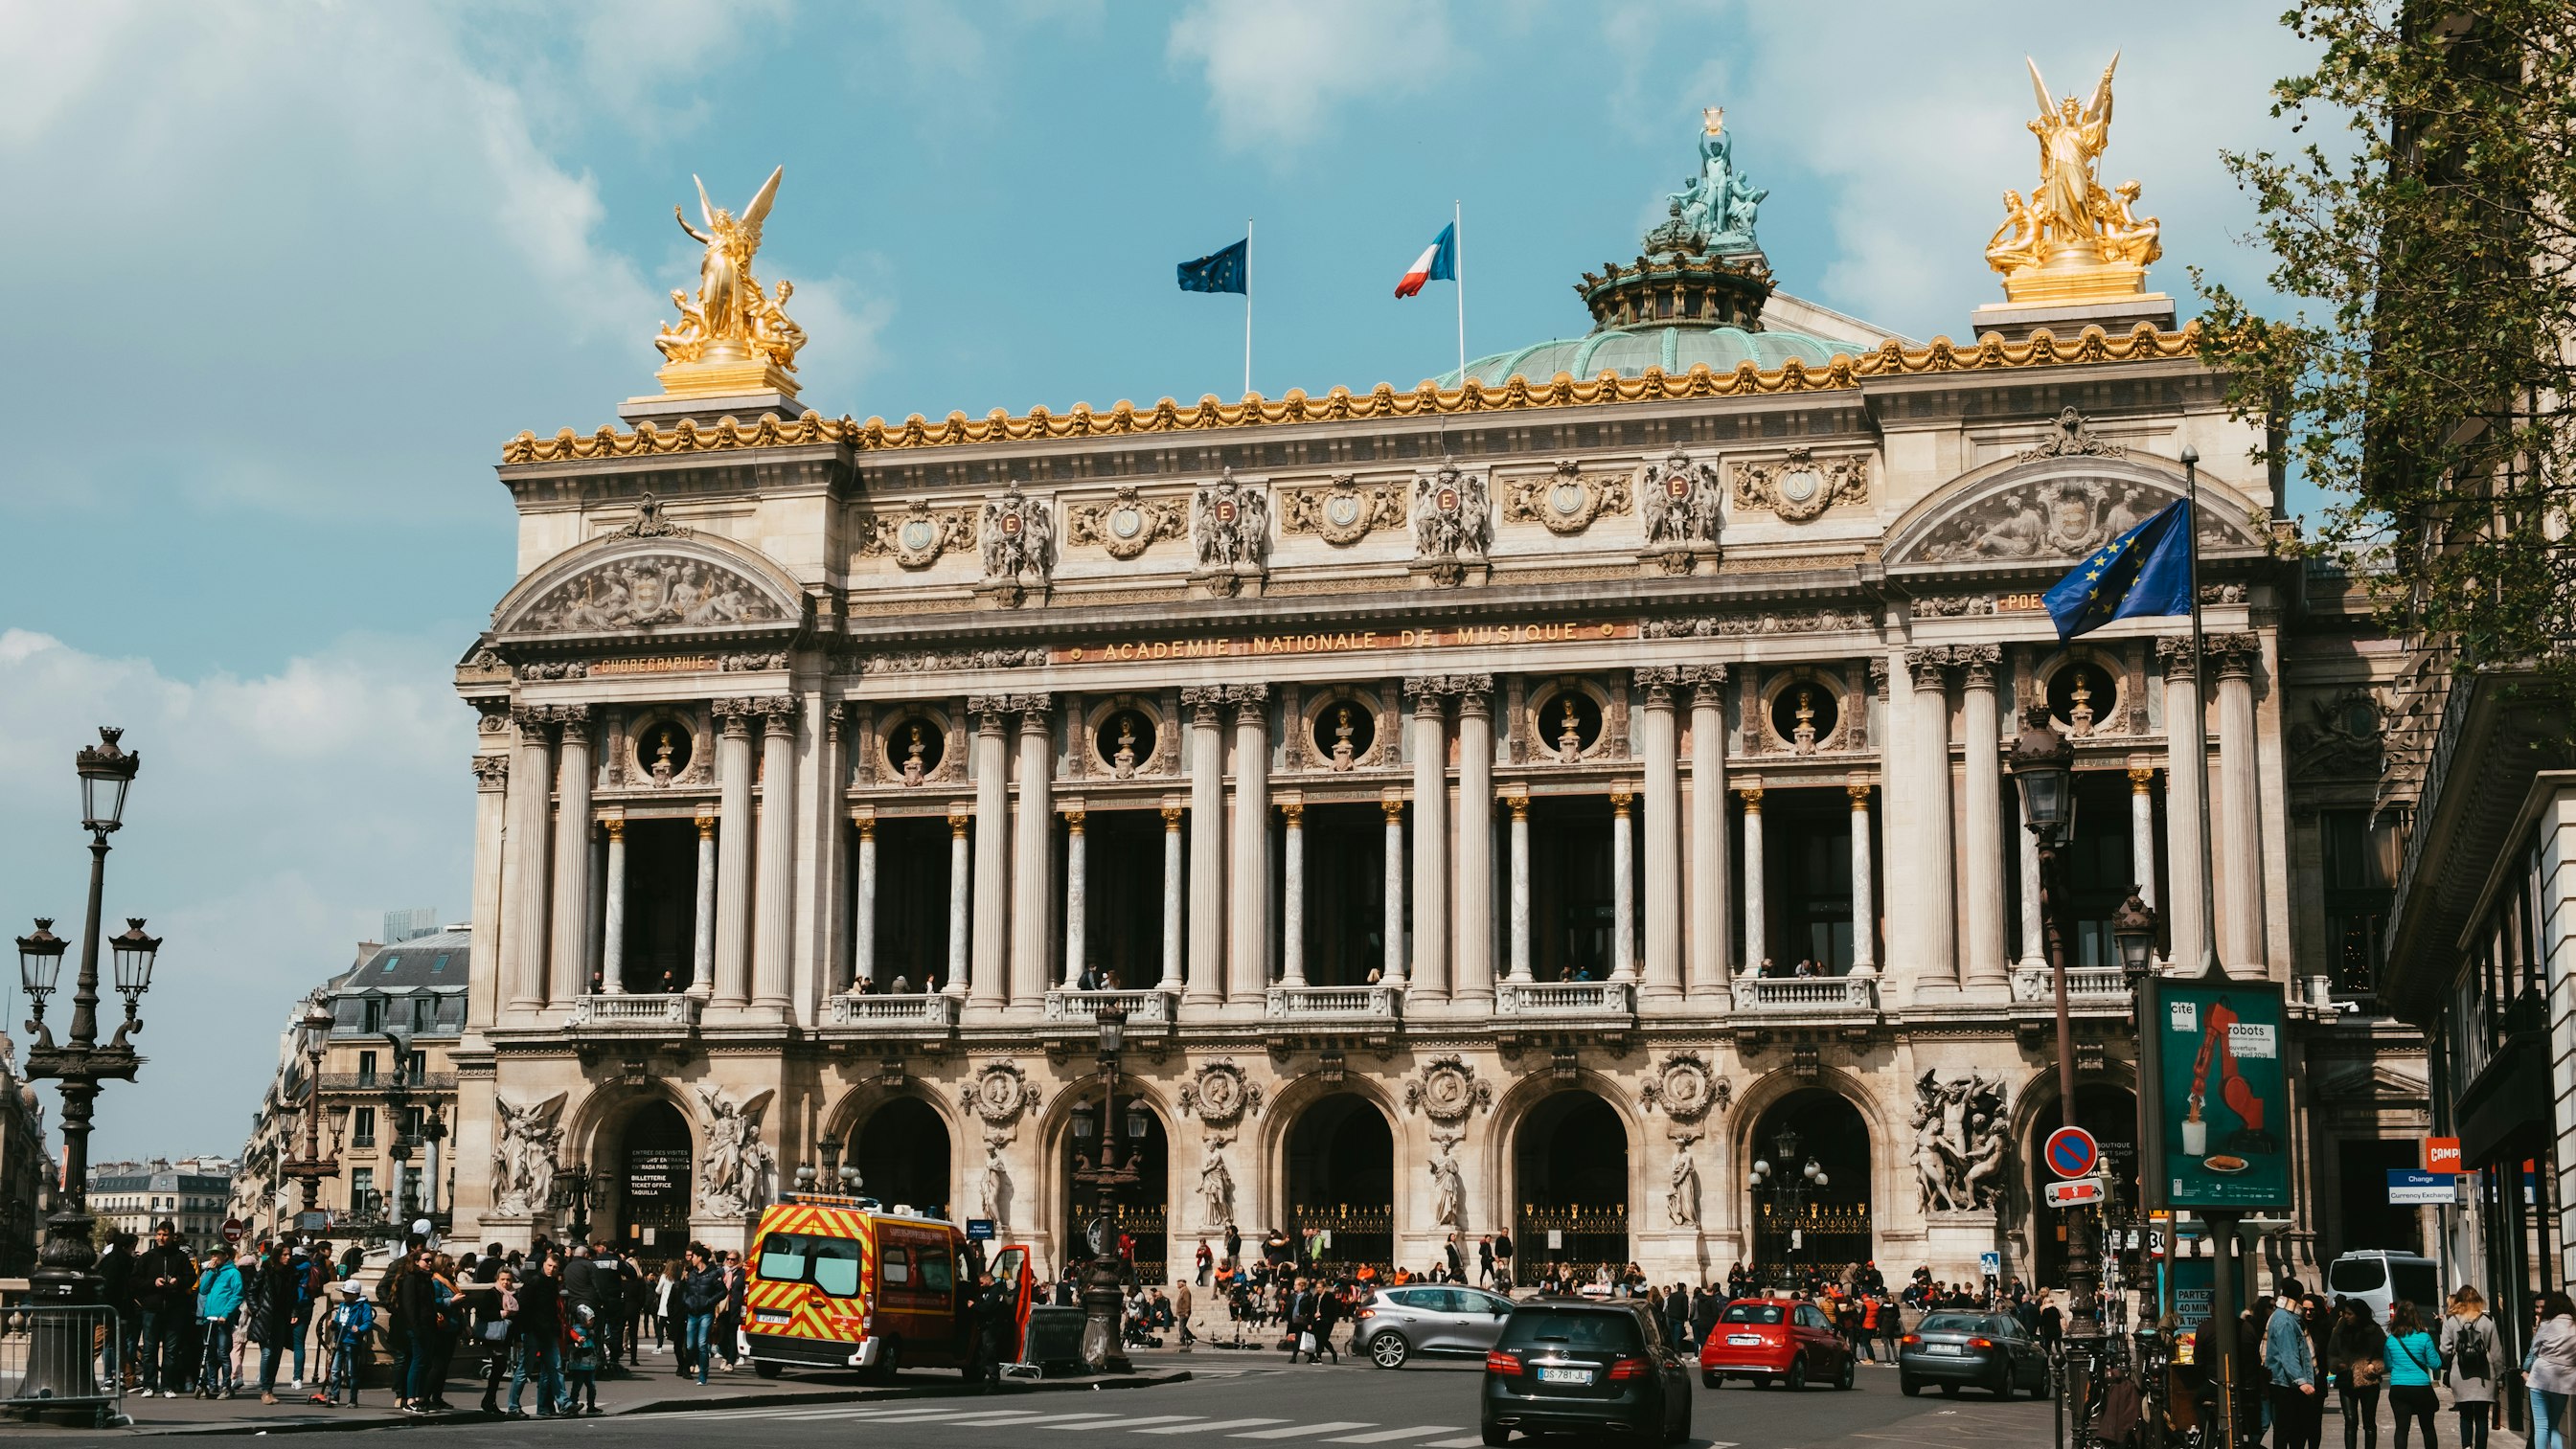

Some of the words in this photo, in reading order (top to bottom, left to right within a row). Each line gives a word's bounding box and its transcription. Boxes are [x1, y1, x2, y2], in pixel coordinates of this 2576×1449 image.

[1672, 481, 1682, 495] E
[1442, 493, 1452, 508] E
[1220, 505, 1230, 519] E
[1006, 518, 1015, 532] E
[1103, 638, 1229, 661] ACADEMIE
[1253, 631, 1377, 654] NATIONALE
[1401, 628, 1433, 647] DE
[1457, 623, 1578, 645] MUSIQUE
[602, 655, 705, 673] CHOREGRAPHIE
[2171, 1002, 2193, 1014] cité
[2228, 1024, 2265, 1036] robots
[2407, 1175, 2434, 1184] Change
[2178, 1290, 2210, 1300] PARTEZ
[2178, 1303, 2190, 1312] 40
[1543, 1368, 1584, 1380] DS-781-JL
